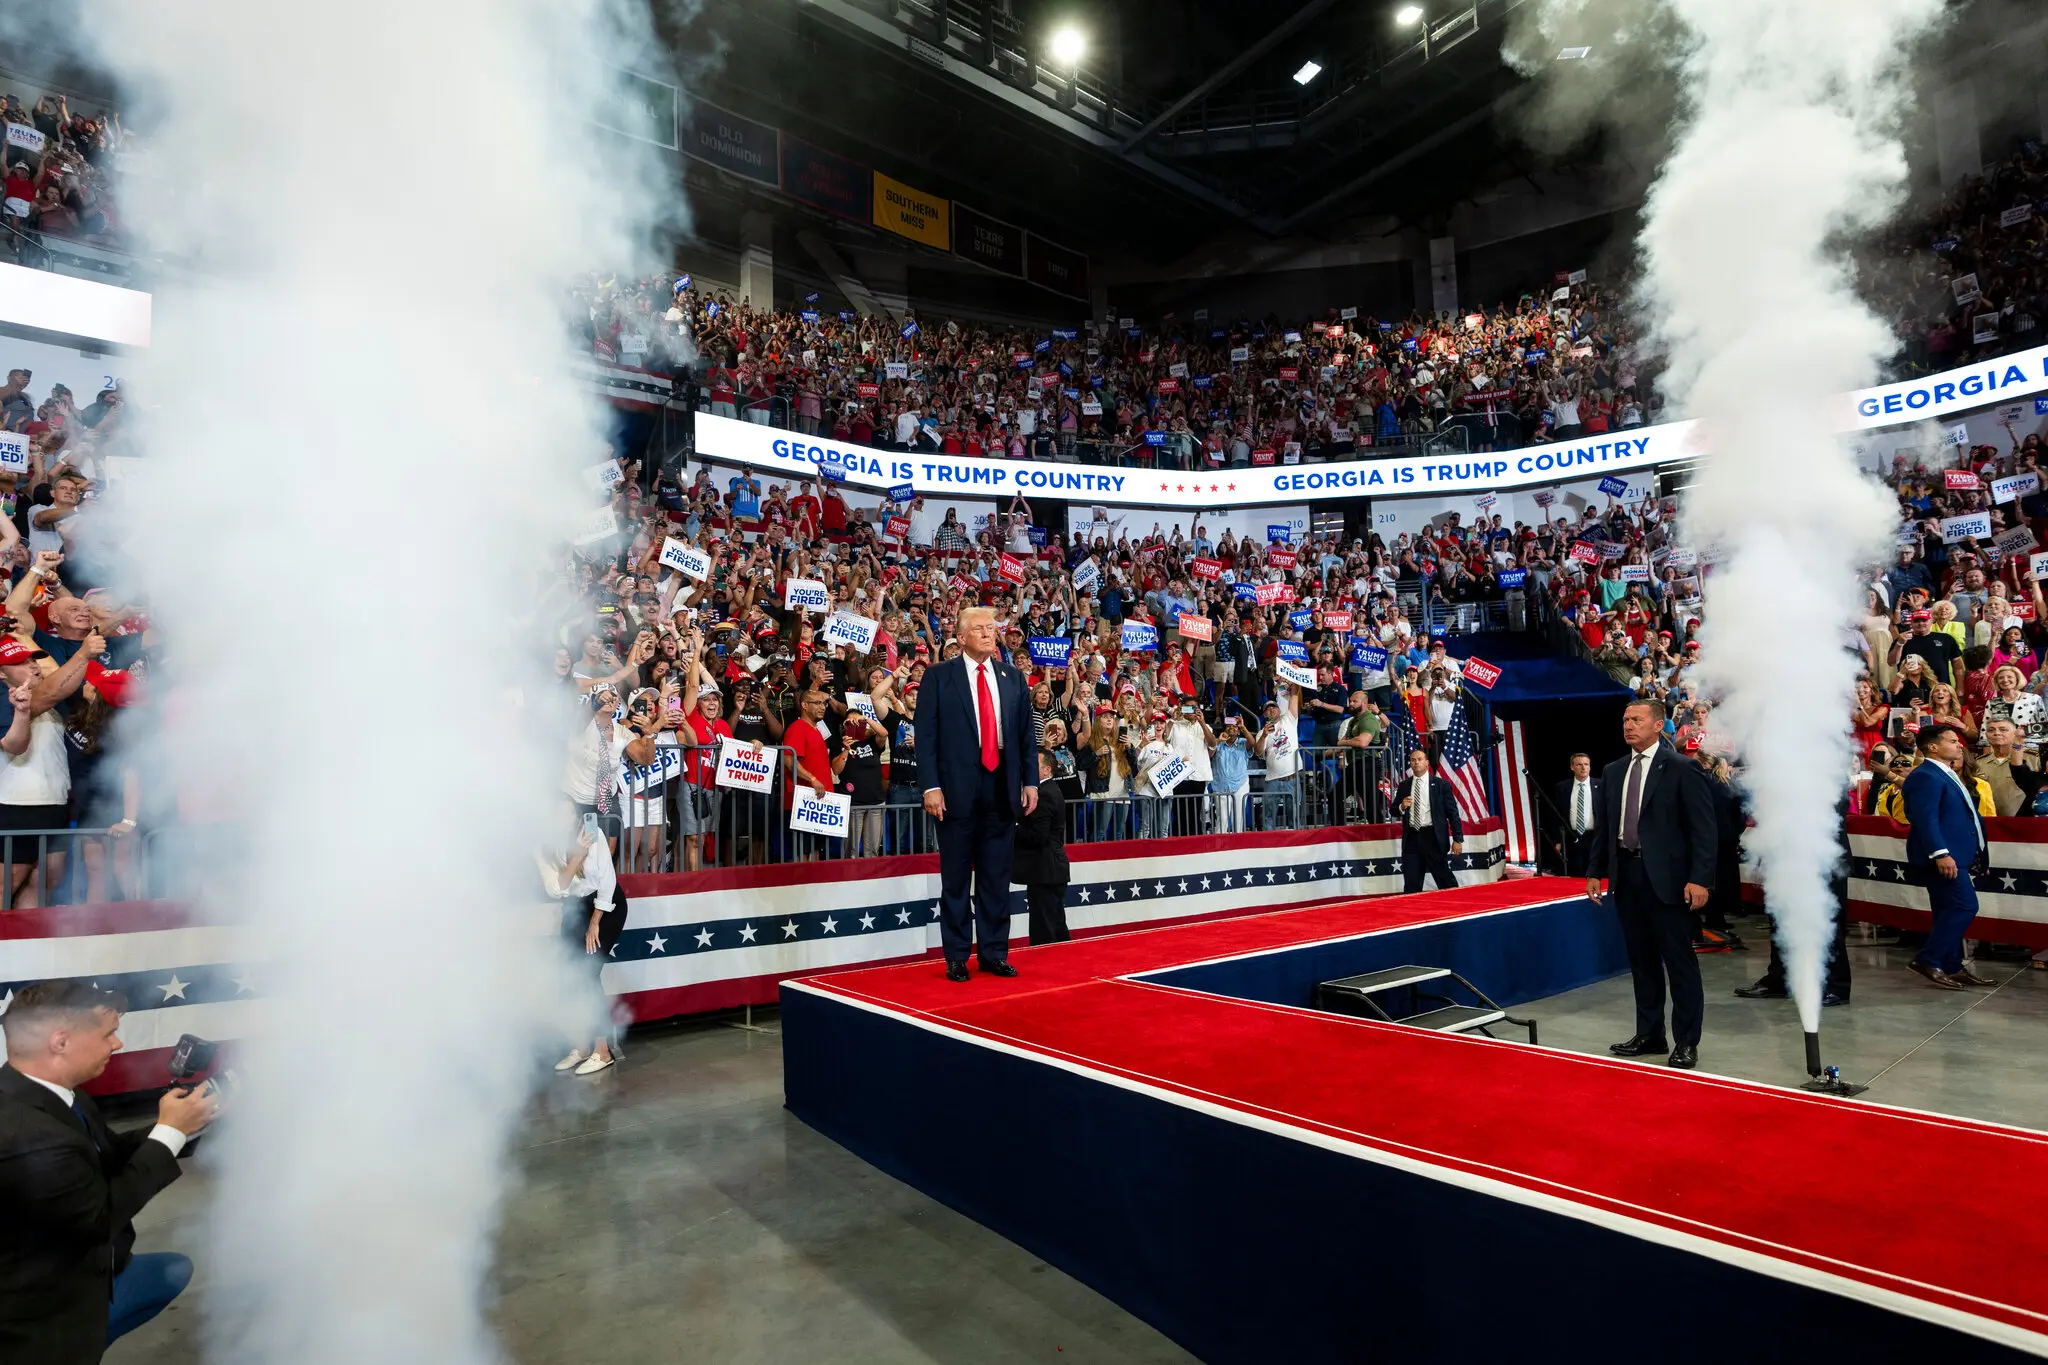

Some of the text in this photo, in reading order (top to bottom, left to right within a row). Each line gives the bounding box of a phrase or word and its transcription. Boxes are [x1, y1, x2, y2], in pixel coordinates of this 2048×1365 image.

[8, 127, 42, 142] TRUMP
[719, 123, 744, 144] OLD
[700, 131, 763, 168] DOMINION
[885, 189, 940, 221] SOUTHERN
[900, 211, 925, 230] MISS
[973, 226, 1005, 247] TEXAS
[973, 238, 1006, 260] STATE
[1858, 365, 2028, 417] GEORGIA
[1274, 437, 1650, 491] GEORGIA IS TRUMP COUNTRY
[892, 462, 913, 480] IS
[922, 464, 1006, 485] TRUMP
[1015, 470, 1125, 492] COUNTRY
[1604, 478, 1625, 489] TRUMP
[889, 486, 912, 496] TRUMP
[1628, 487, 1645, 498] 211
[1995, 479, 2035, 492] TRUMP
[1999, 484, 2030, 495] VANCE
[890, 519, 909, 529] TRUMP
[1287, 520, 1304, 529] 210
[1379, 513, 1396, 523] 210
[1948, 519, 1984, 530] YOU'RE
[1076, 521, 1091, 531] 209
[1946, 525, 1987, 538] FIRED!
[2000, 532, 2026, 547] YOU'RE
[2001, 537, 2033, 554] FIRED!
[665, 550, 704, 575] FIRED!
[671, 546, 703, 566] YOU'RE
[1271, 554, 1295, 562] TRUMP
[1003, 558, 1023, 574] TRUMP
[1074, 563, 1093, 579] YOU'RE
[1195, 561, 1219, 571] TRUMP
[1197, 567, 1215, 575] VANCE
[1074, 566, 1096, 585] FIRED!
[793, 588, 825, 598] YOU'RE
[1257, 585, 1283, 597] TRUMP
[790, 595, 827, 606] FIRED!
[836, 618, 870, 636] YOU'RE
[1181, 618, 1210, 630] TRUMP
[1184, 624, 1207, 634] VANCE
[830, 625, 870, 646] FIRED!
[1124, 630, 1155, 639] TRUMP
[1032, 641, 1070, 652] TRUMP
[1036, 648, 1066, 658] VANCE
[1280, 644, 1305, 653] TRUMP
[1283, 648, 1304, 657] VANCE
[1356, 648, 1386, 659] TRUMP
[1358, 654, 1382, 664] VANCE
[1279, 668, 1313, 685] FIRED!
[1468, 660, 1498, 678] TRUMP
[1469, 667, 1492, 682] VANCE
[737, 749, 763, 763] VOTE
[725, 758, 770, 774] DONALD
[1156, 756, 1181, 779] YOU'RE
[727, 769, 765, 784] TRUMP
[1157, 760, 1188, 790] FIRED!
[802, 799, 841, 815] YOU'RE
[797, 808, 844, 827] FIRED!
